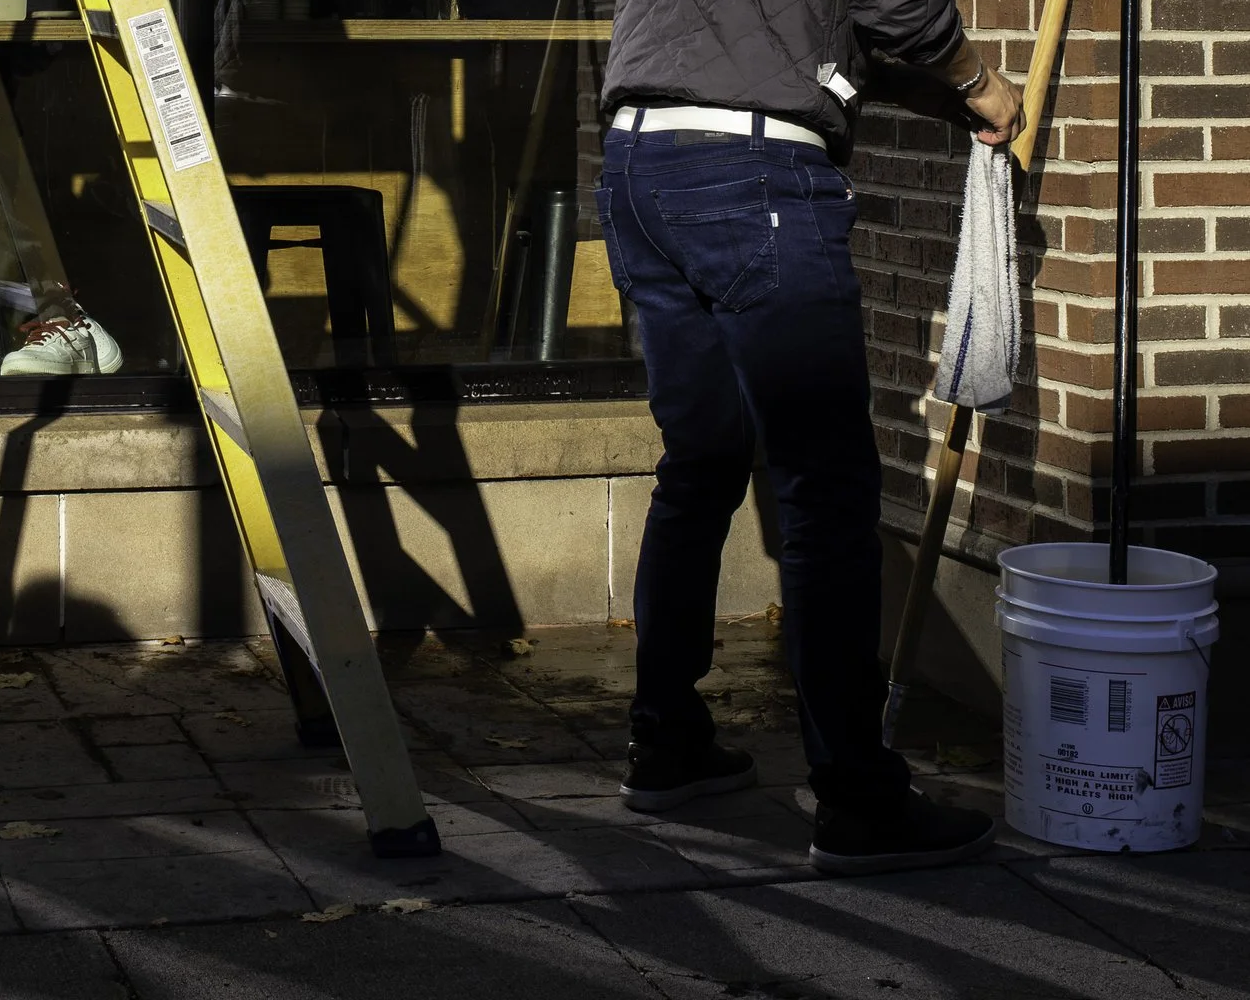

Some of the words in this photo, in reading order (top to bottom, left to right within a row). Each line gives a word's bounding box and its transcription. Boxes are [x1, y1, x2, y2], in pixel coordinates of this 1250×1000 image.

[1173, 694, 1194, 708] AVISO
[1046, 763, 1095, 778] STACKING
[1100, 772, 1134, 781] LIMIT:
[1055, 776, 1079, 787] HIGH
[1095, 783, 1134, 792] PALLET
[1058, 786, 1101, 799] PALLETS
[1108, 792, 1134, 801] HIGH
